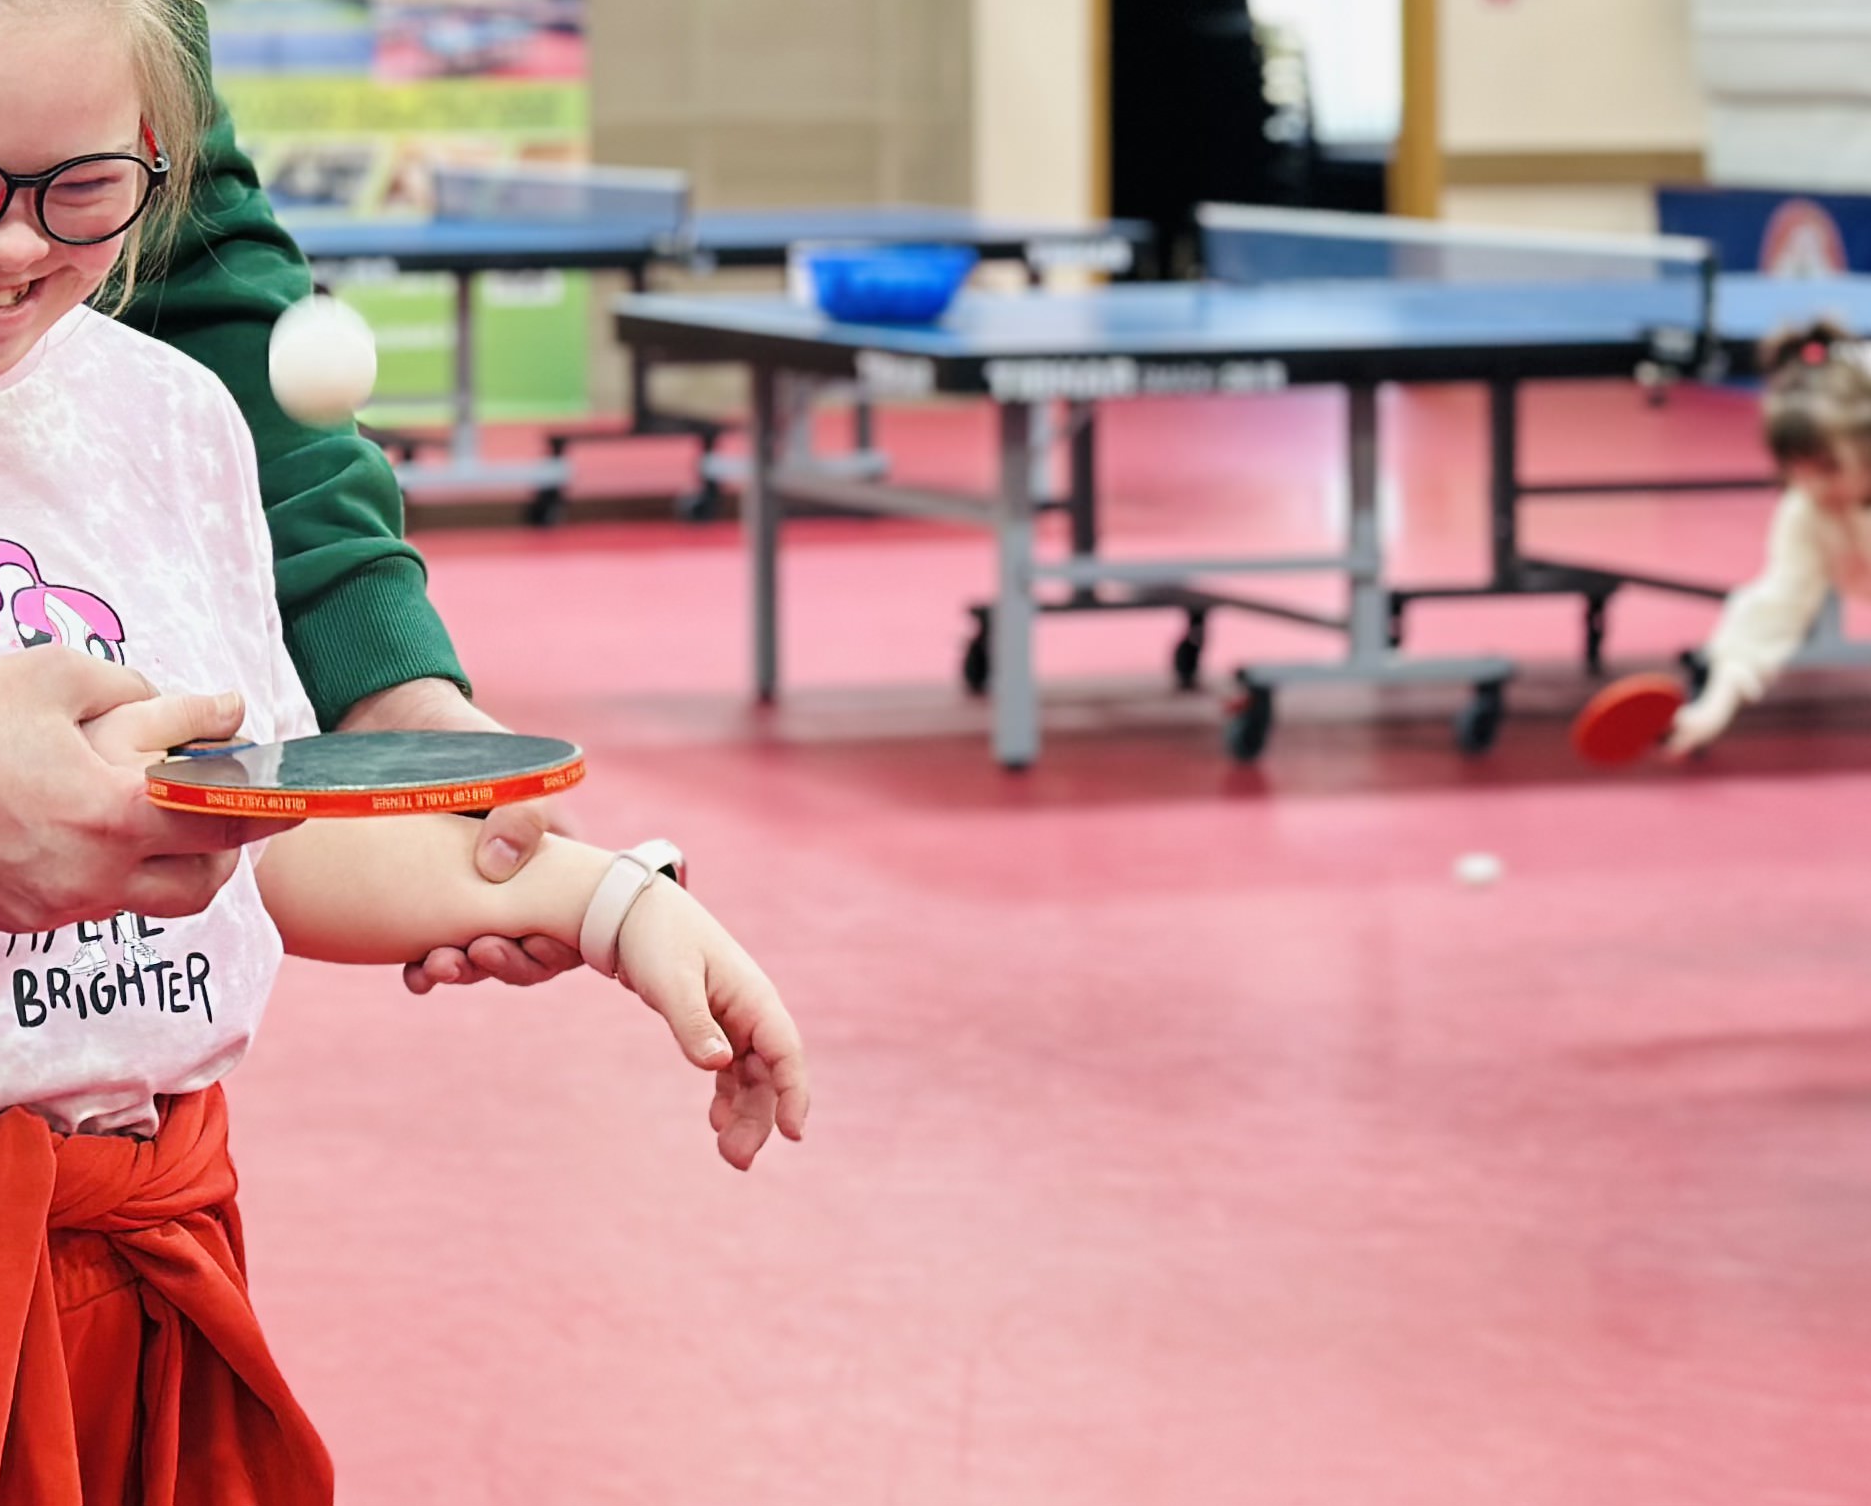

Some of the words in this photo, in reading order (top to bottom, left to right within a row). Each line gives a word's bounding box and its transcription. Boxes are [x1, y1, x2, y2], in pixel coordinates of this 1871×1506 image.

[238, 794, 266, 809] TABLE
[372, 794, 413, 810] TENNIS
[416, 791, 452, 807] TABLE
[12, 951, 213, 1029] BRIGHTER
